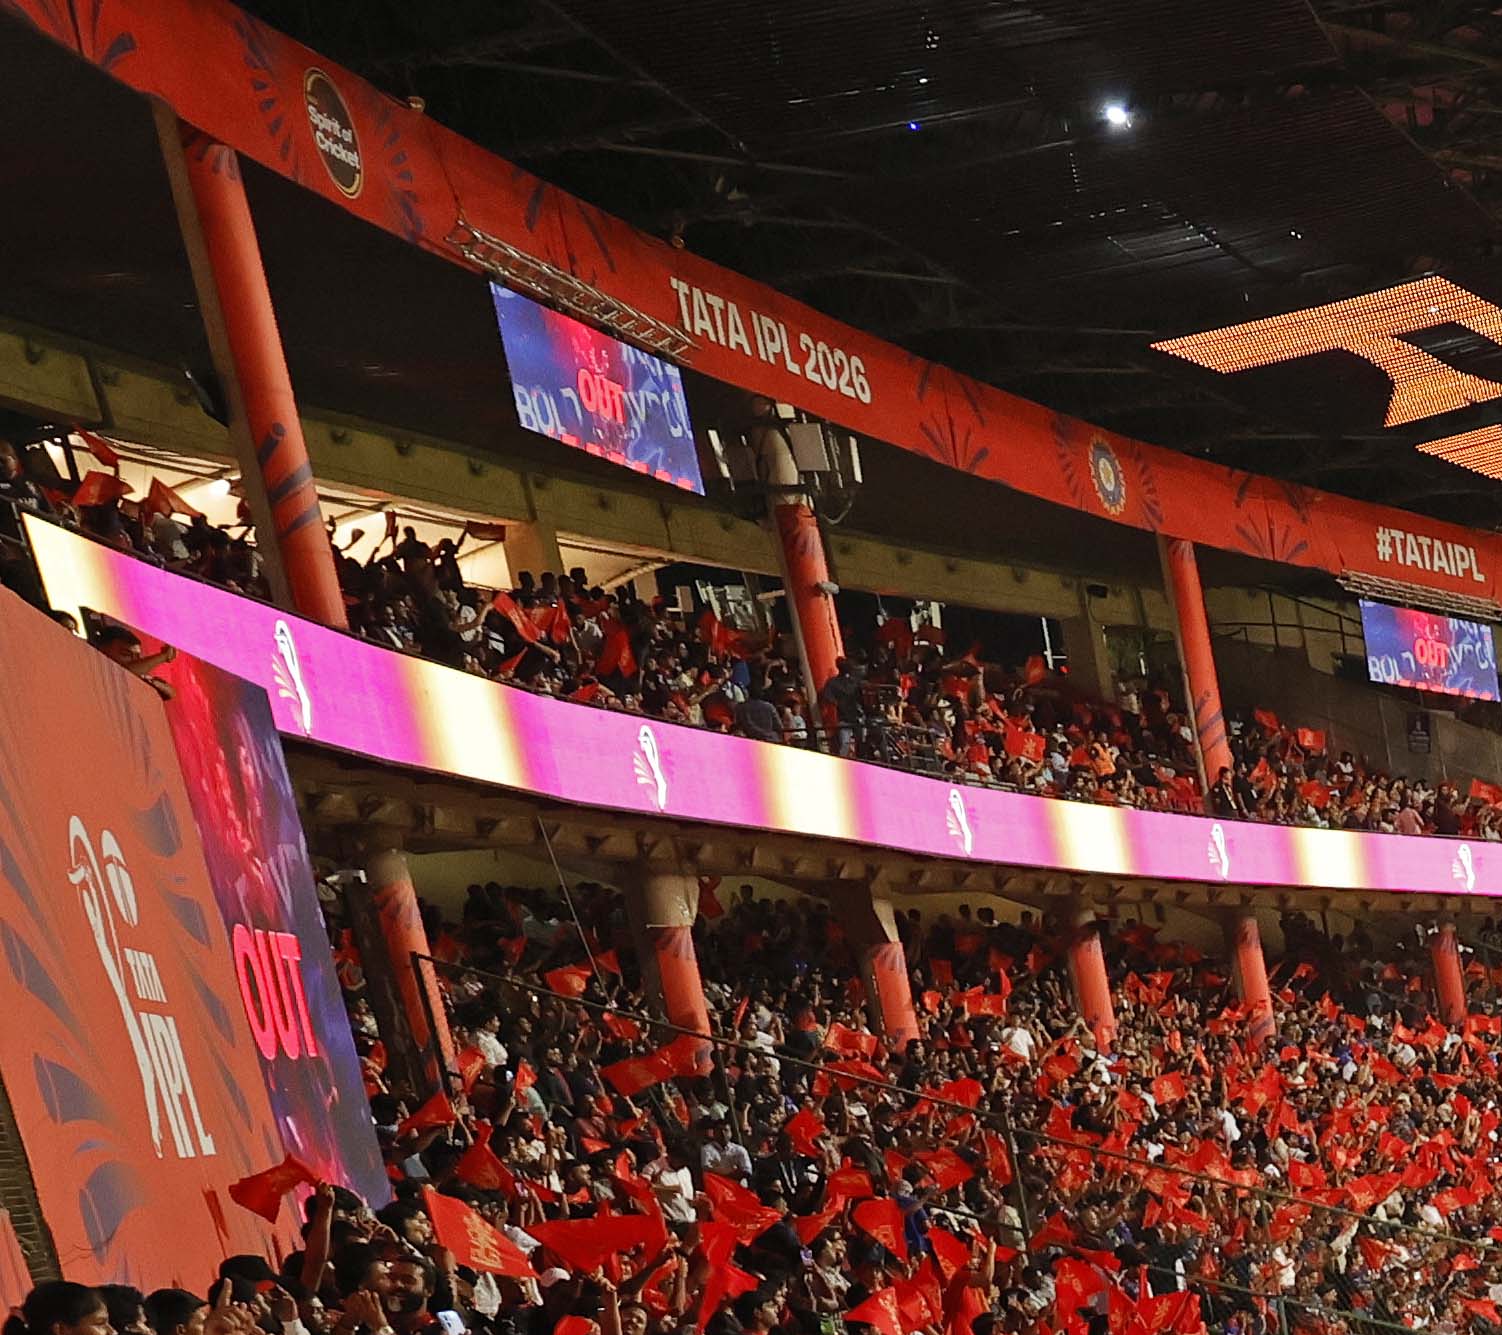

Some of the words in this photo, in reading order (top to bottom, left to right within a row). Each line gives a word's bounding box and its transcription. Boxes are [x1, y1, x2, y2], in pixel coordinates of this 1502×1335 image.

[670, 275, 753, 357] TATA
[750, 311, 802, 376] IPL
[799, 333, 872, 405] 2026
[577, 367, 626, 426] OUT
[1375, 525, 1487, 583] #TATAIPL
[1413, 637, 1451, 669] OUT
[232, 922, 319, 1061] OUT
